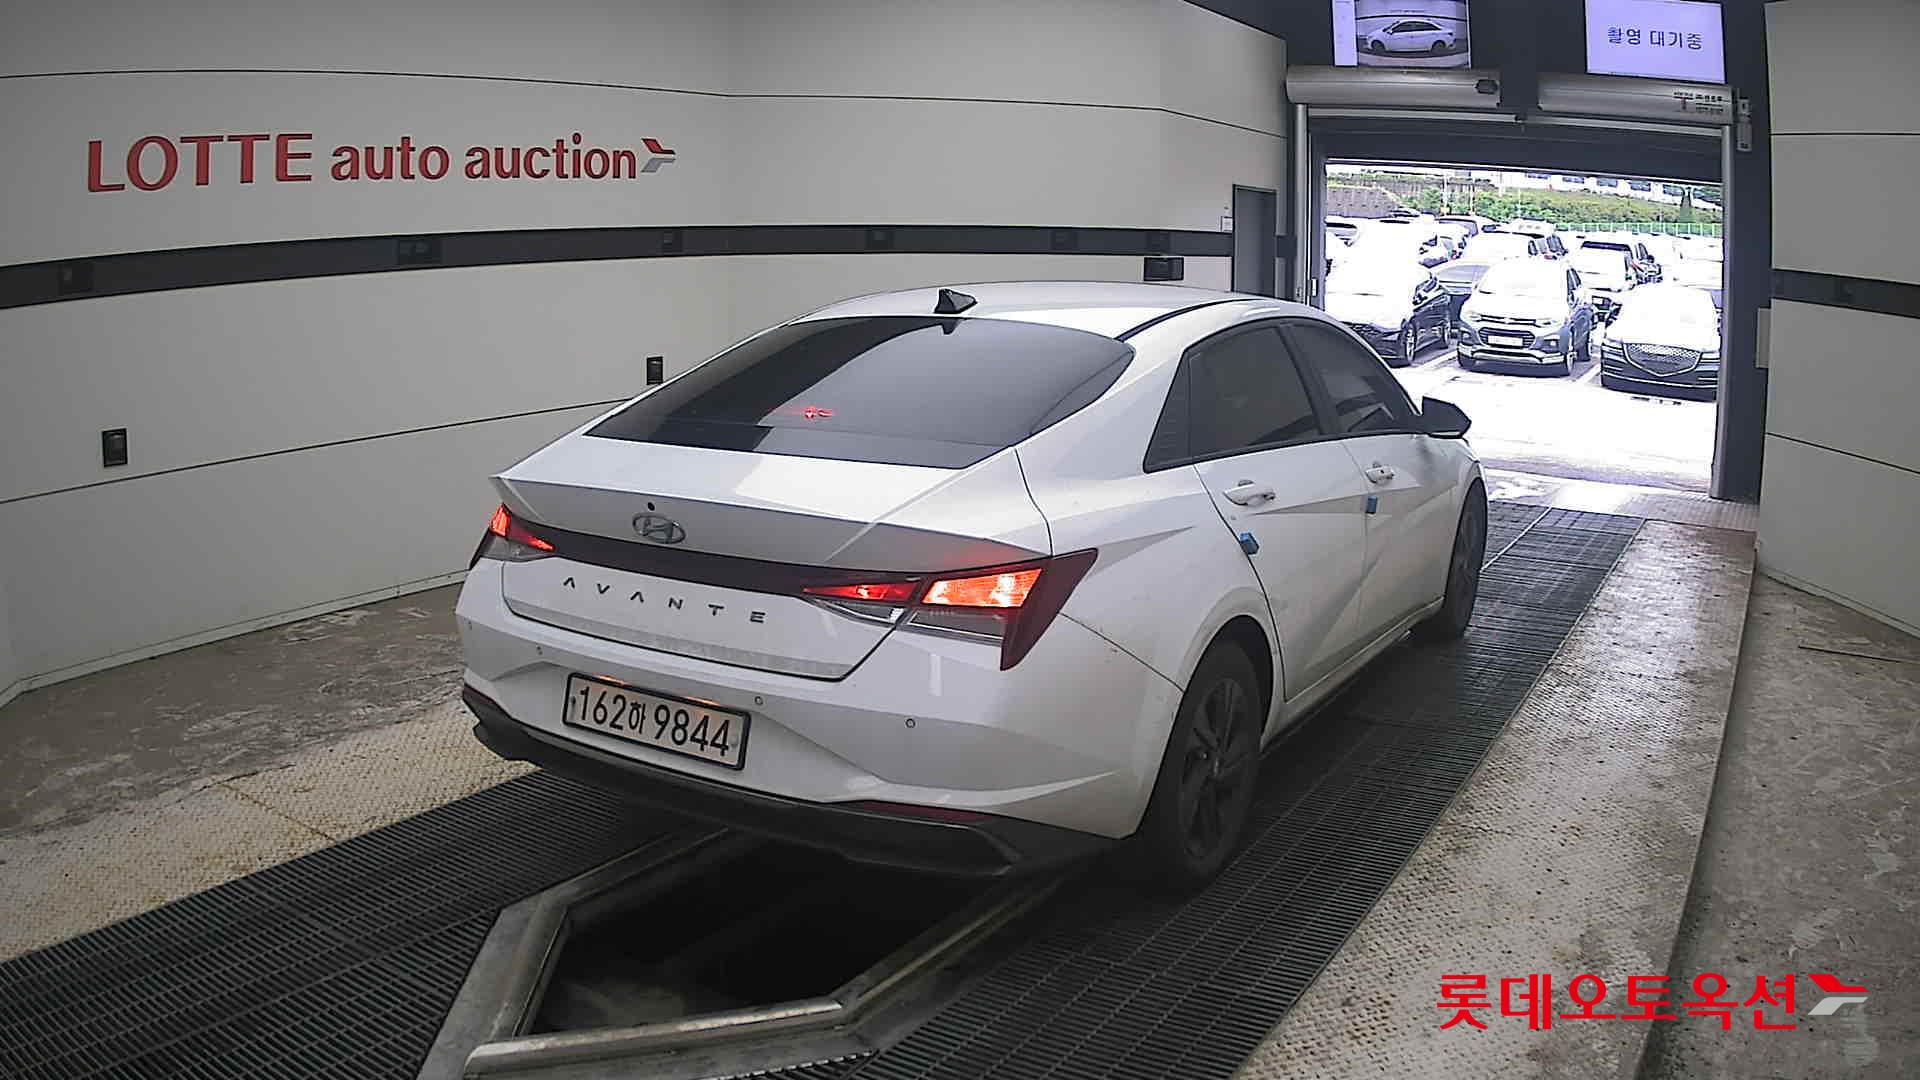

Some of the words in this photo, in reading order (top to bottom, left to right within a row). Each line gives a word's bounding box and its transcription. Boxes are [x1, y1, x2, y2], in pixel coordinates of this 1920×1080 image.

[1649, 30, 1702, 50] 대기중
[87, 133, 313, 193] LOTTE
[330, 136, 450, 181] auto
[463, 132, 637, 180] auction
[563, 576, 767, 624] AVANTE
[579, 686, 646, 735] 162하
[653, 704, 731, 757] 9844
